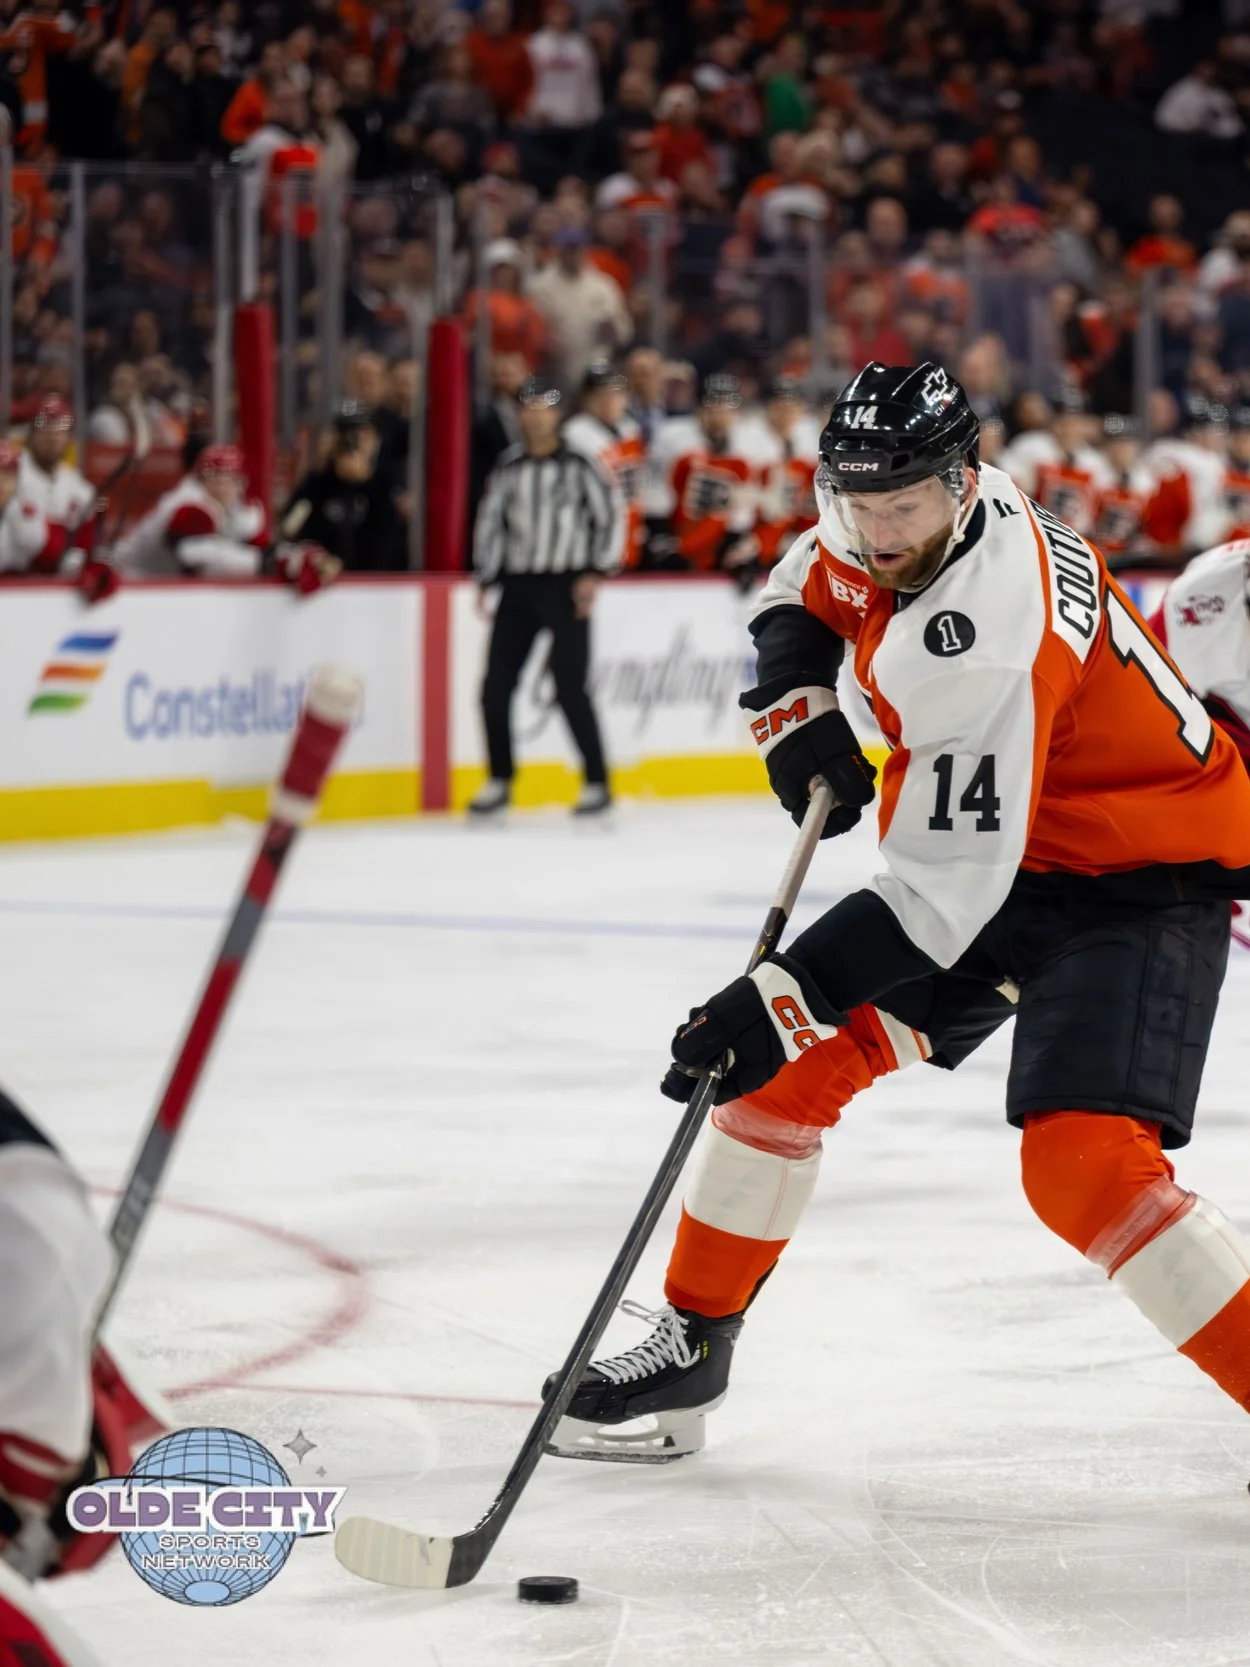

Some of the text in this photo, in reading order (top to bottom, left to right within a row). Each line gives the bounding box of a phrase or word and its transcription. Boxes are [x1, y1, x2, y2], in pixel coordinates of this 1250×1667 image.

[850, 405, 879, 430] 14
[838, 462, 879, 472] CCM
[937, 615, 961, 652] 1
[928, 754, 1001, 832] 14
